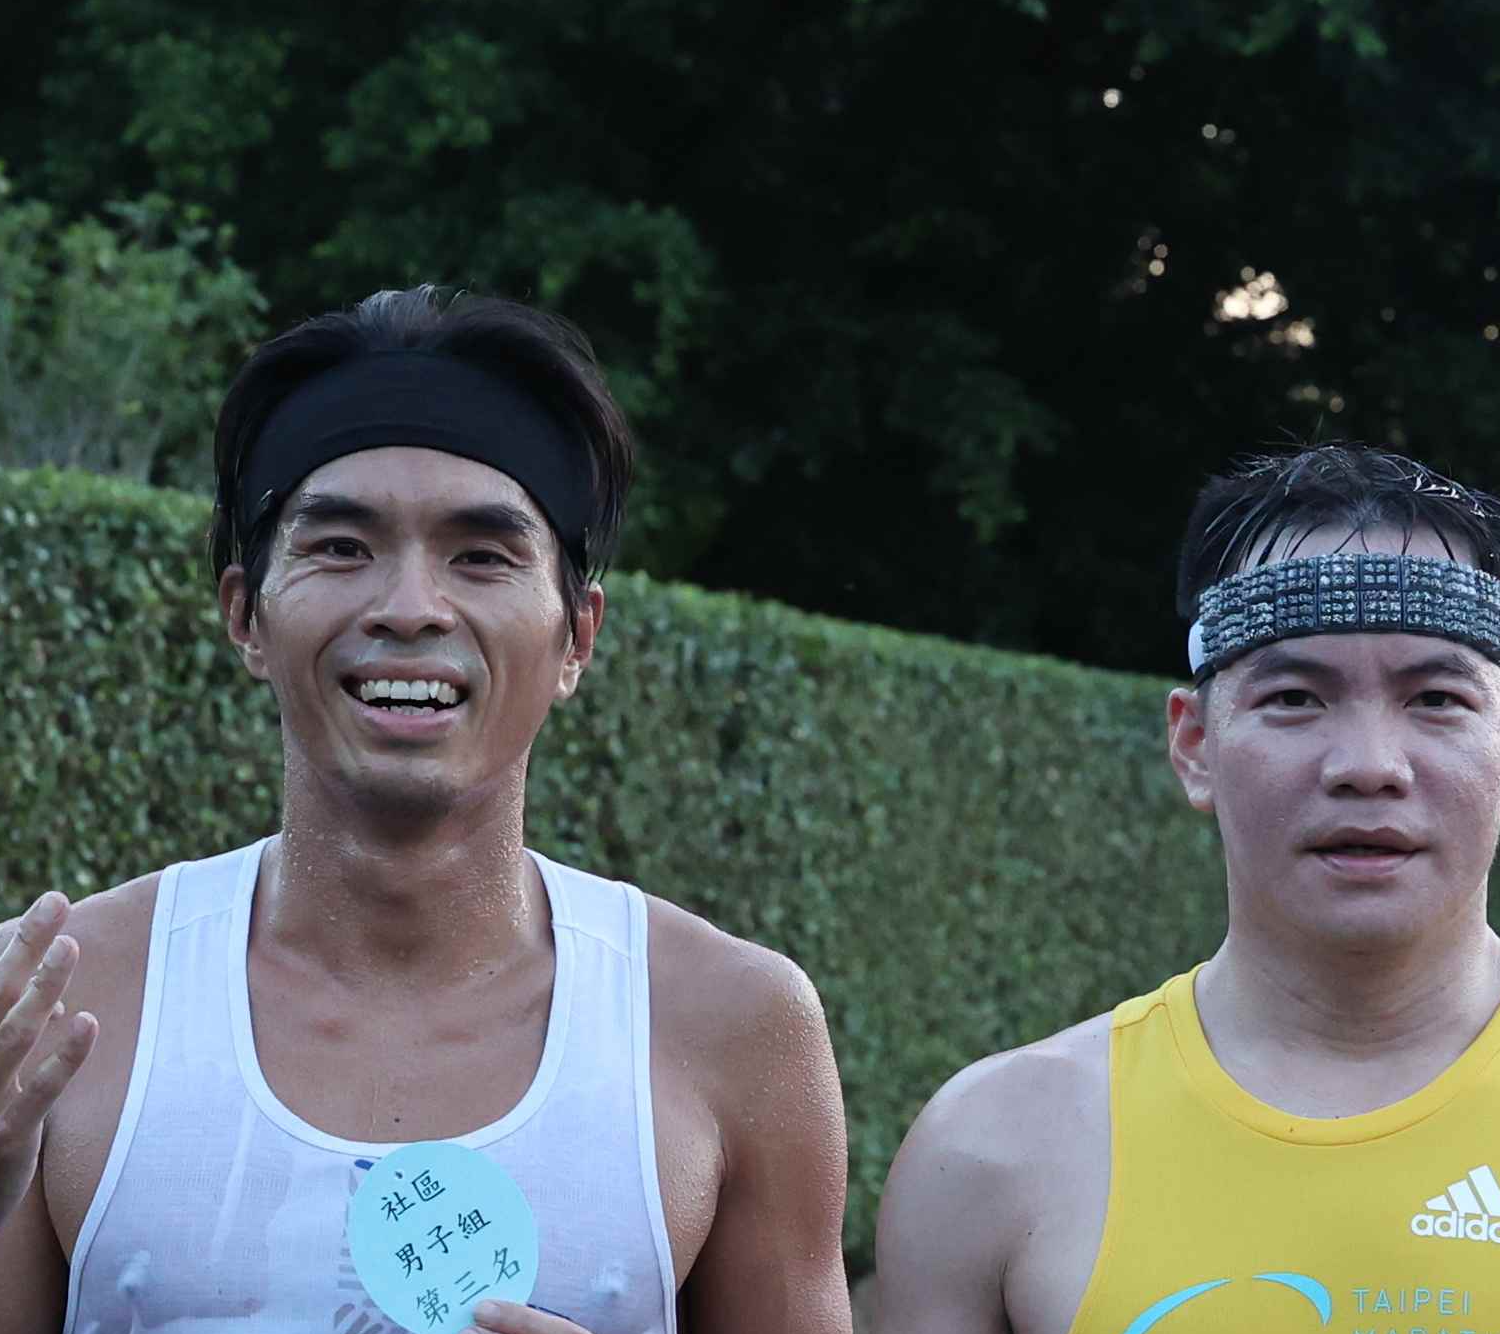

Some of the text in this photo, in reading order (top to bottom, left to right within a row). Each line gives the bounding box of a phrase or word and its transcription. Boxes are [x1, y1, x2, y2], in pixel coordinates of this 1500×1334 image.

[381, 1169, 446, 1222] 社區
[395, 1208, 492, 1280] 男子組
[416, 1246, 522, 1329] 第三名
[1352, 1287, 1471, 1316] TAIPEI
